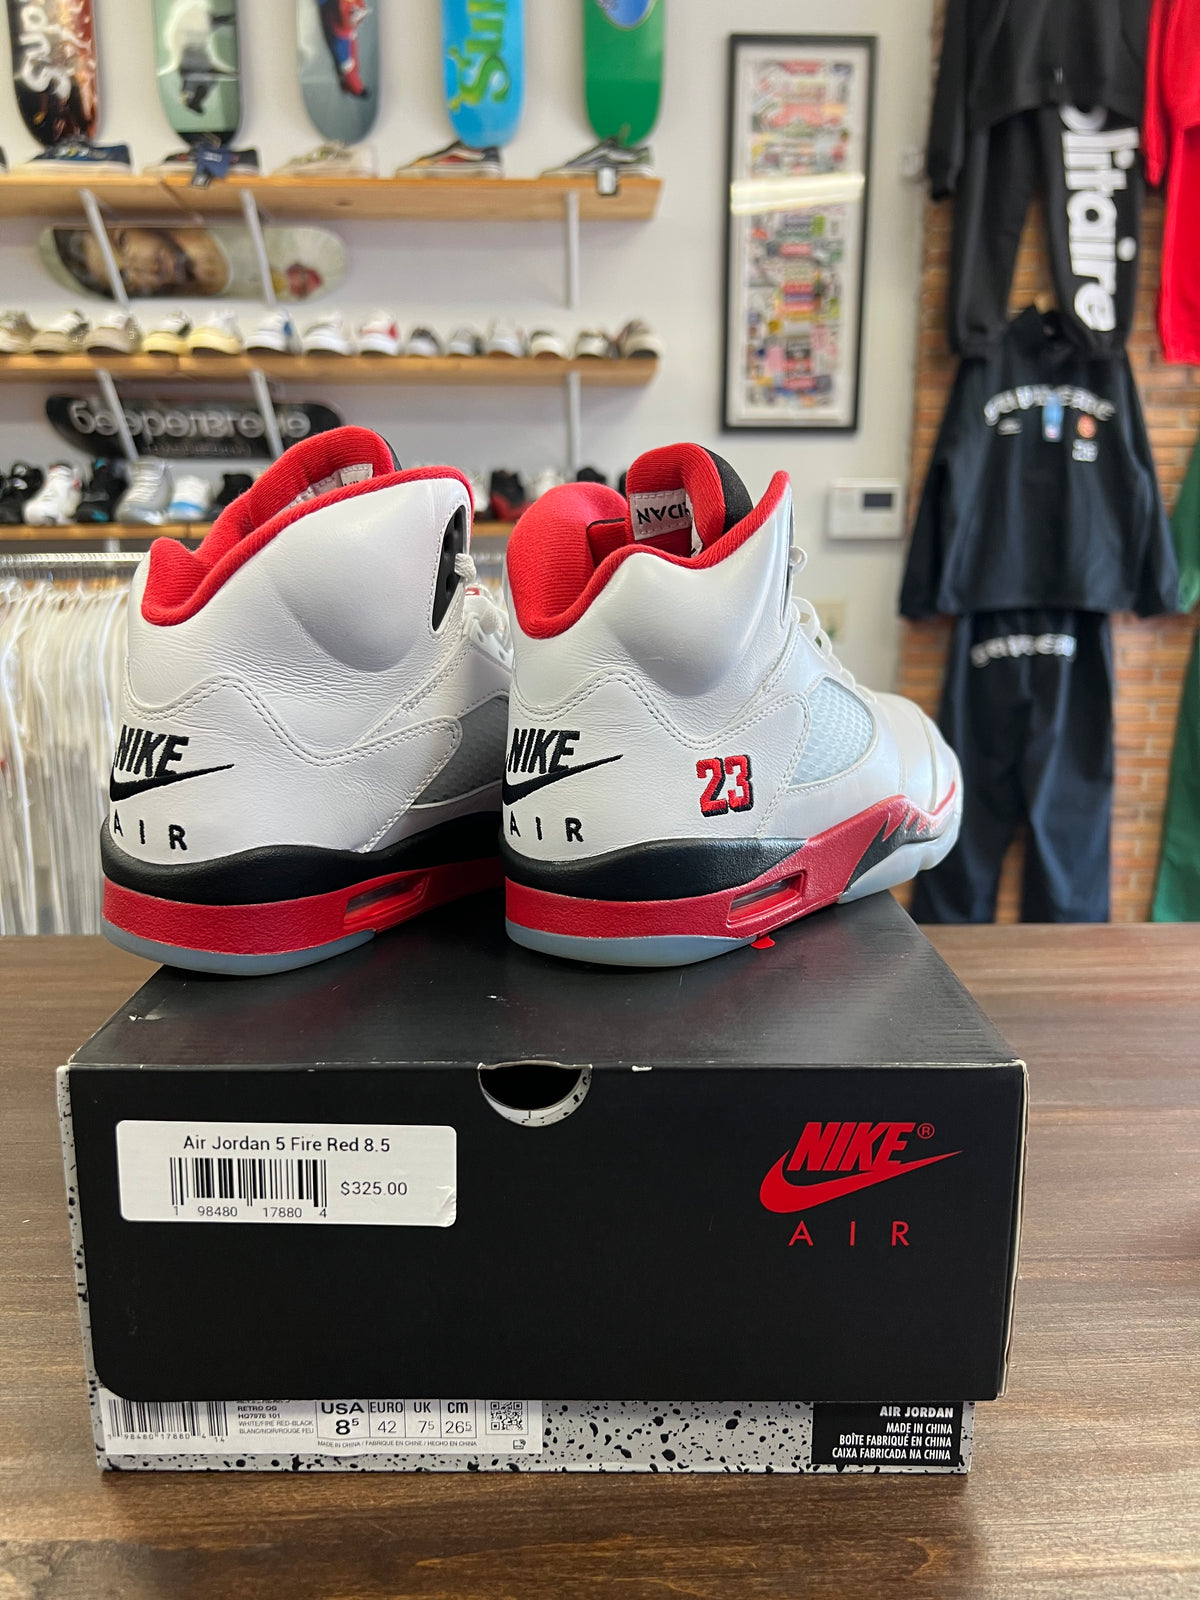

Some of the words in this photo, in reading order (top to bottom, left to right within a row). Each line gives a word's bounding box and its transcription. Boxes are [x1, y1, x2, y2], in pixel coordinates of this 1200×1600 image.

[114, 724, 190, 777] NIKE
[506, 728, 580, 774] NIKE
[696, 754, 755, 817] 23
[114, 808, 188, 851] AIR
[510, 810, 584, 843] AIR
[184, 1135, 206, 1149] Air
[211, 1136, 270, 1151] Jordan
[276, 1137, 286, 1150] 5
[291, 1137, 322, 1151] Fire
[327, 1138, 359, 1152] Red
[364, 1138, 390, 1153] 8.5
[340, 1180, 408, 1197] $325.00
[198, 1206, 238, 1218] 98480
[263, 1207, 303, 1218] 17880
[319, 1208, 327, 1218] 4
[788, 1220, 910, 1247] AIR
[321, 1402, 365, 1415] USA
[370, 1402, 403, 1413] EURO
[413, 1402, 432, 1413] UK
[447, 1402, 469, 1413] cm
[879, 1406, 901, 1417] AIR
[904, 1407, 954, 1418] JORDAN
[377, 1420, 397, 1434] 42
[886, 1422, 912, 1434] MADE
[913, 1423, 923, 1434] IN
[925, 1423, 953, 1434] CHINA
[911, 1436, 922, 1446] EN
[924, 1436, 952, 1447] CHINA
[832, 1447, 858, 1458] CAIXA
[859, 1448, 907, 1459] FABRICADA
[909, 1448, 922, 1459] NA
[923, 1449, 951, 1460] CHINA
